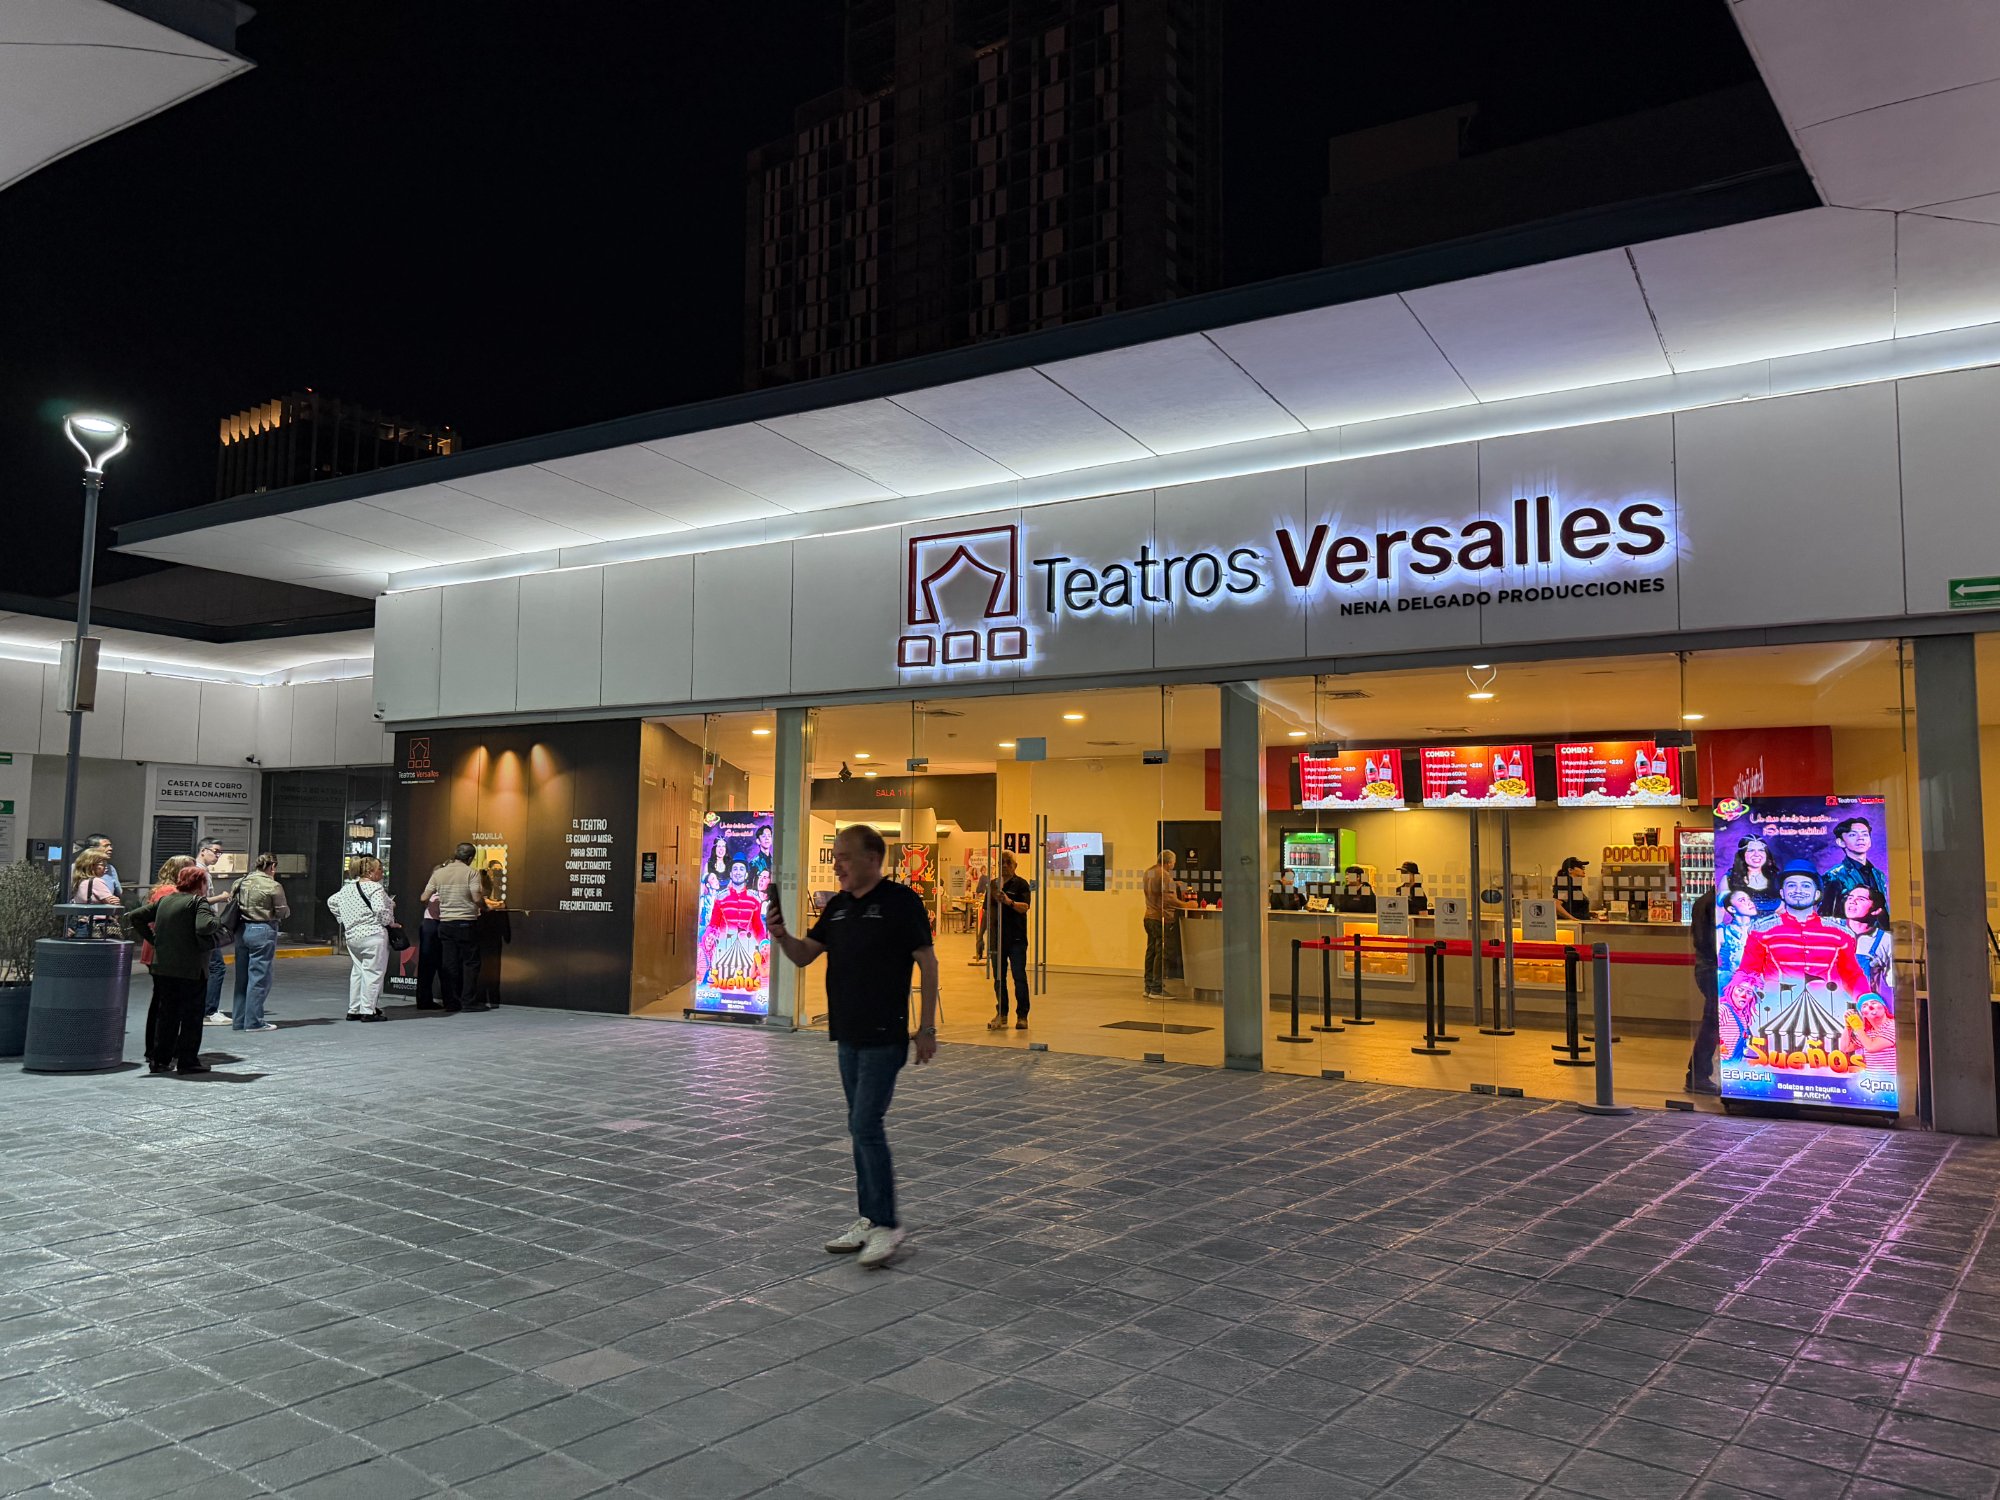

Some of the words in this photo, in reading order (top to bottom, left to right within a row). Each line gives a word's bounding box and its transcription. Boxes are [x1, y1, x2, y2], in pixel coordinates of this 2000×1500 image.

[1033, 548, 1264, 613] Teatros
[1276, 496, 1666, 588] Versalles
[1340, 600, 1391, 616] NENA
[1397, 591, 1491, 612] DELGADO
[1498, 578, 1664, 603] PRODUCCIONES
[1589, 746, 1594, 754] 2
[167, 780, 200, 788] CASETA
[174, 790, 248, 799] ESTACIONAMIENTO
[876, 789, 895, 797] SALA
[573, 819, 579, 828] EL
[580, 819, 608, 830] TEATRO
[566, 834, 573, 843] ES
[574, 835, 590, 843] COMO
[571, 848, 586, 857] PARA
[586, 847, 608, 857] SENTIR
[565, 861, 612, 870] COMPLETAMENTE
[580, 874, 606, 884] EFECTOS
[572, 888, 583, 896] HAY
[584, 888, 595, 898] QUE
[596, 888, 602, 896] IR
[1748, 1037, 1867, 1073] Sueños
[1723, 1070, 1740, 1080] 26
[1743, 1071, 1771, 1082] Abril
[1860, 1079, 1895, 1093] 4pm
[1804, 1092, 1831, 1100] AREMA
